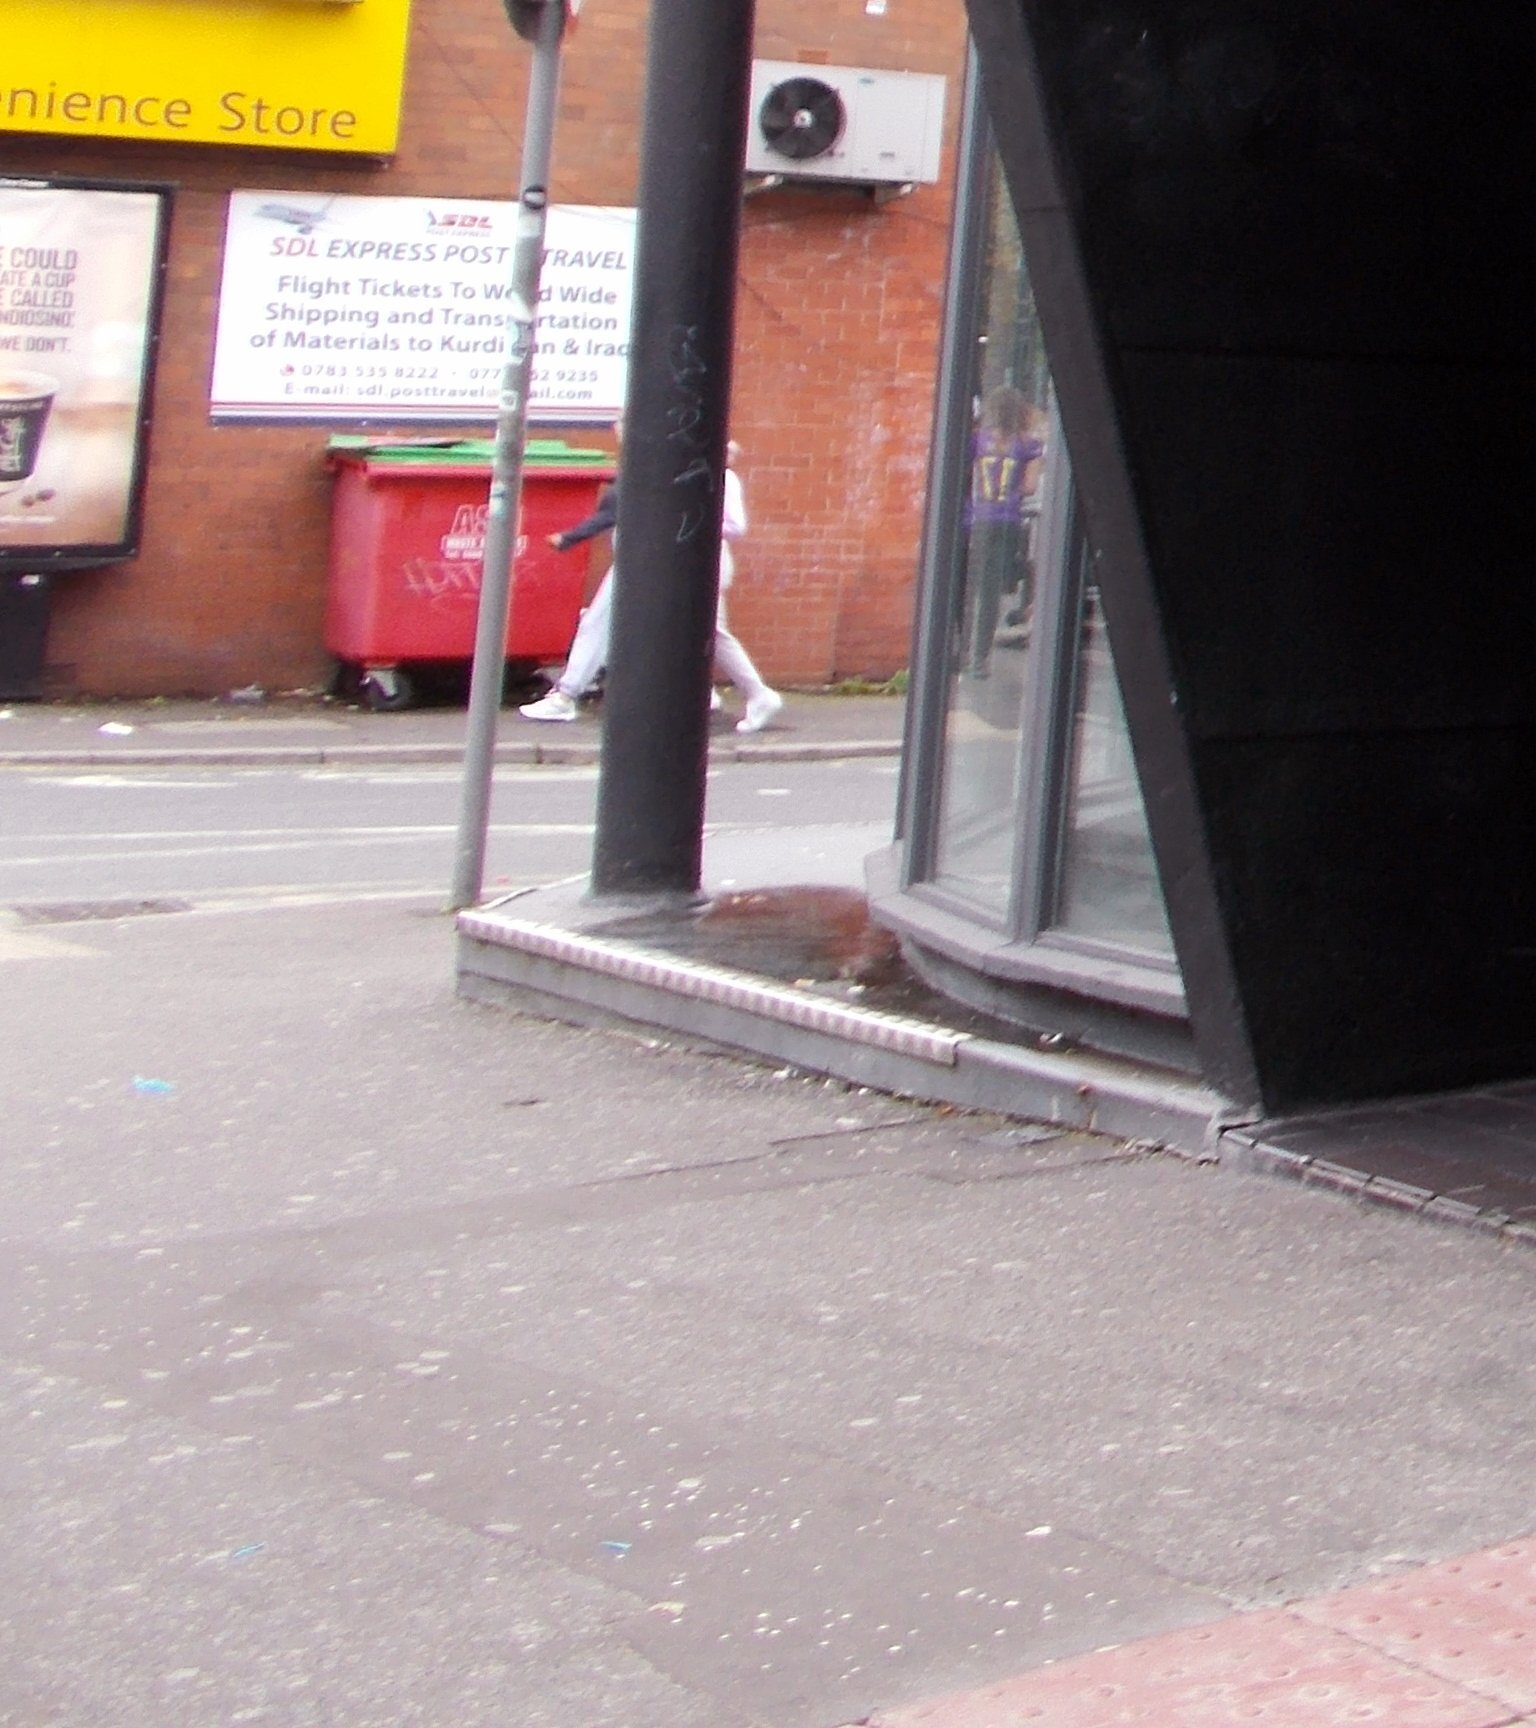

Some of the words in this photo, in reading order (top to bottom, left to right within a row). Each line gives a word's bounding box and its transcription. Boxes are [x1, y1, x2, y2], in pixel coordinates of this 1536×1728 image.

[0, 81, 192, 129] nience
[218, 91, 357, 139] Store
[10, 247, 78, 271] COULD
[270, 237, 319, 257] SDL
[326, 239, 437, 261] EXPRESS
[444, 245, 509, 264] POST
[542, 249, 627, 270] TRAVEL
[31, 272, 41, 287] A
[45, 272, 75, 289] CUP
[278, 275, 350, 299] Flight
[358, 278, 442, 299] Tickets
[450, 282, 475, 300] To
[560, 286, 617, 304] Wide
[10, 289, 73, 308] CALLED
[265, 302, 379, 328] Shipping
[388, 308, 433, 324] and
[251, 330, 278, 348] of
[284, 331, 400, 351] Materials
[409, 337, 432, 352] to
[441, 336, 554, 355] Kurdian
[564, 339, 579, 356] &
